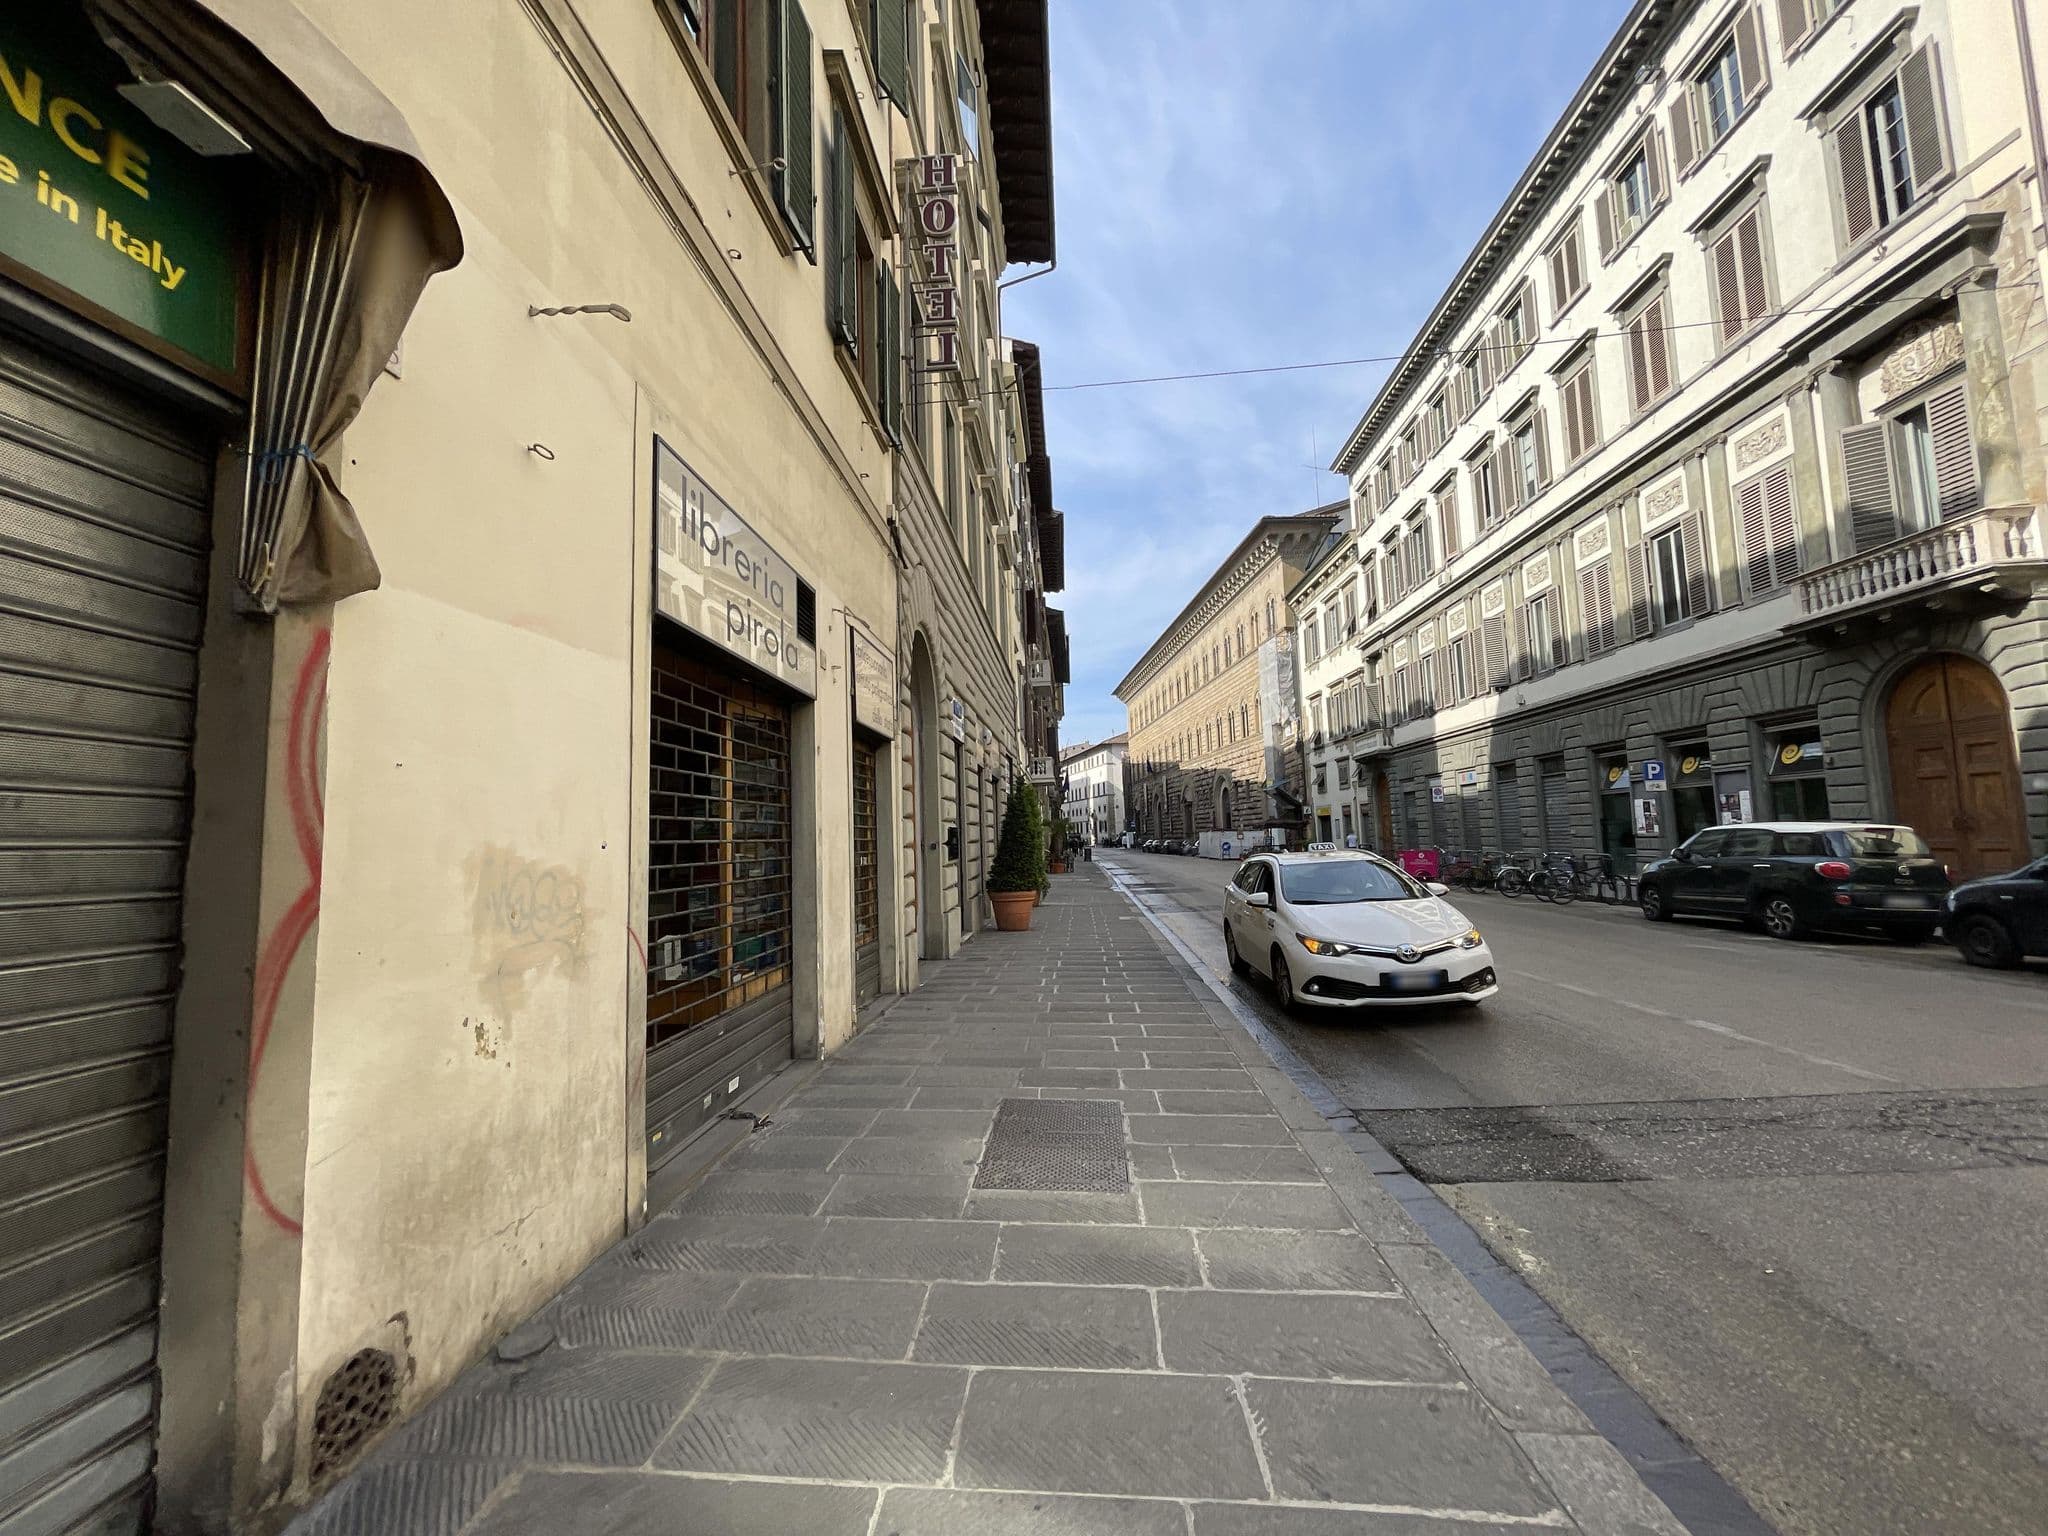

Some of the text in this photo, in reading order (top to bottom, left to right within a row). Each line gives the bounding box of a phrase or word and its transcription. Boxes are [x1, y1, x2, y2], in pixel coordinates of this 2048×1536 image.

[35, 169, 80, 225] in
[95, 206, 187, 291] Italy
[681, 474, 784, 612] libreria
[726, 598, 800, 671] pirola
[1647, 763, 1661, 780] P
[1310, 843, 1335, 851] TAXI
